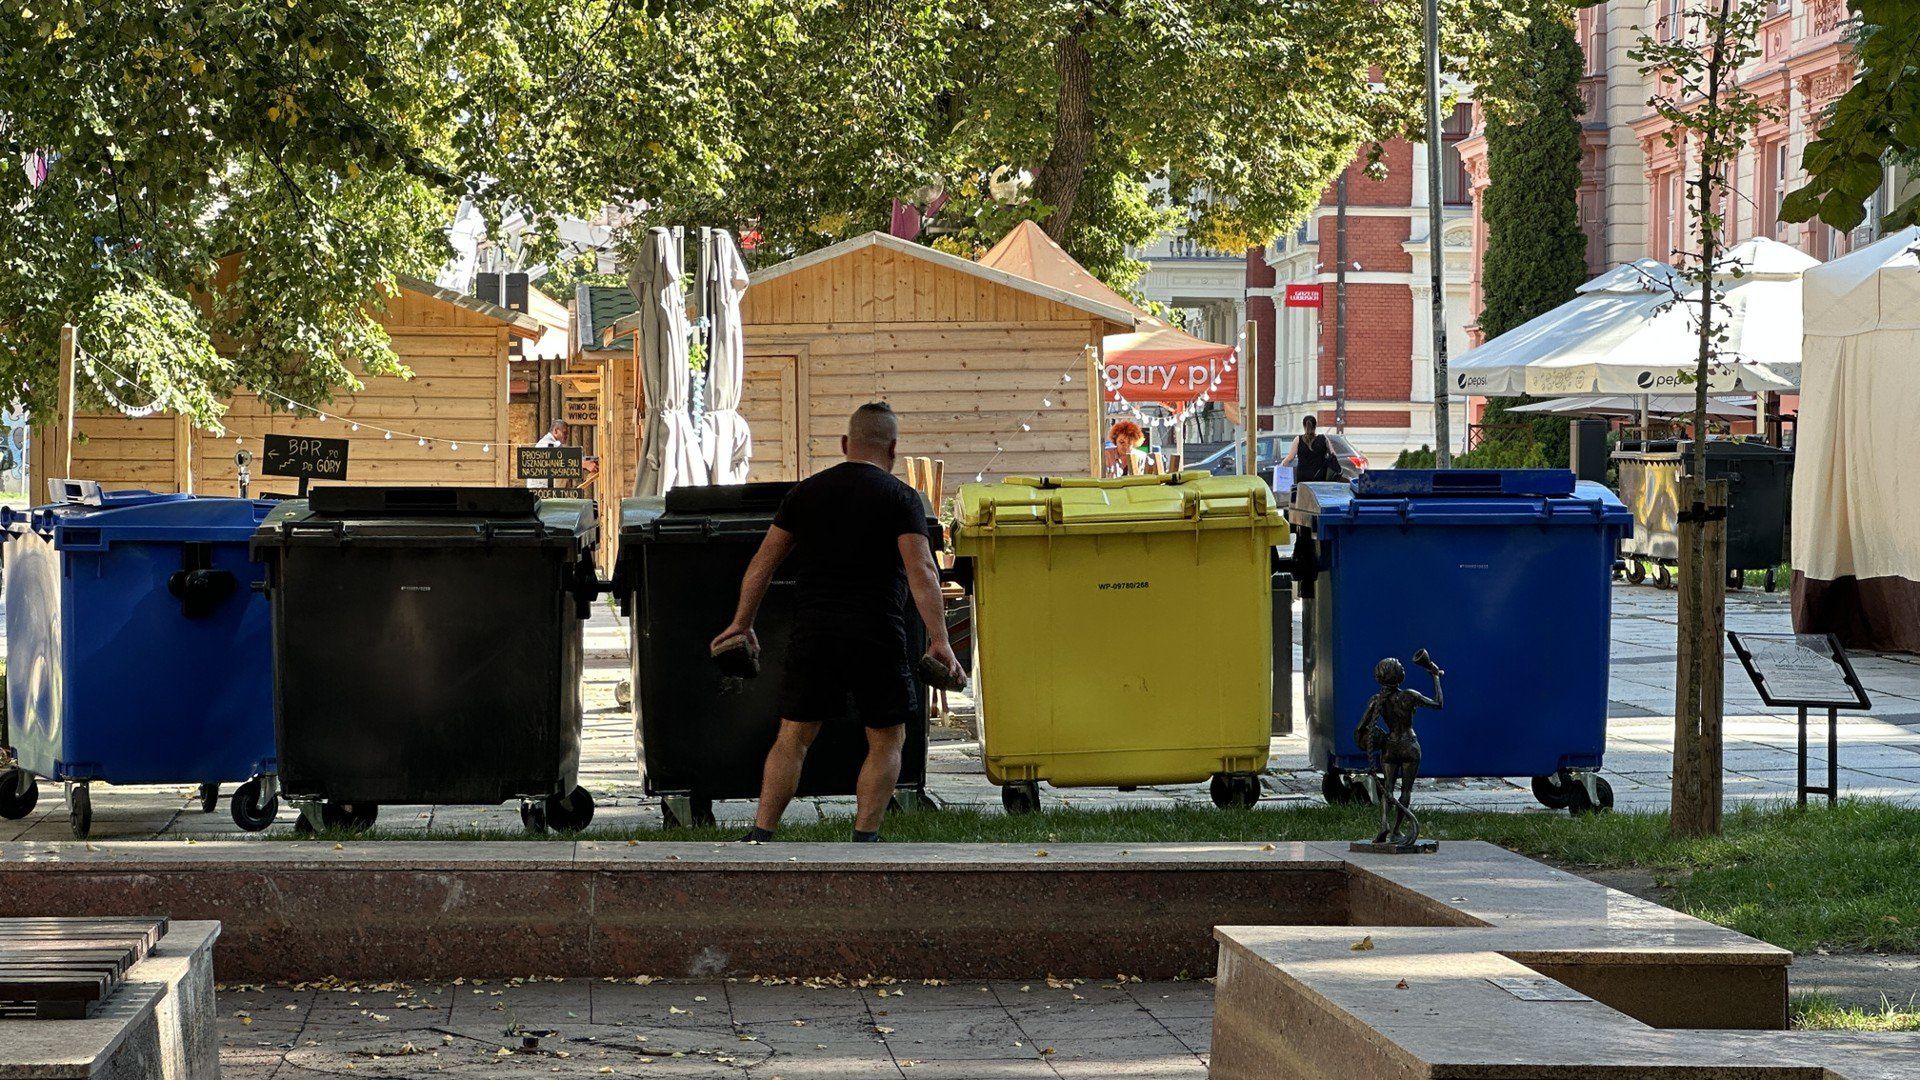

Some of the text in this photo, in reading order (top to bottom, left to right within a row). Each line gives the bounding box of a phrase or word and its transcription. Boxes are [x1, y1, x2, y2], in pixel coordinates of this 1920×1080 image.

[1467, 374, 1487, 387] pepsi
[288, 439, 322, 456] BAR
[329, 449, 339, 459] PO
[521, 450, 563, 460] PROSIMY O
[316, 456, 341, 473] GÓRY
[521, 468, 548, 476] NASZYCH
[1098, 581, 1150, 590] WP-09780/268
